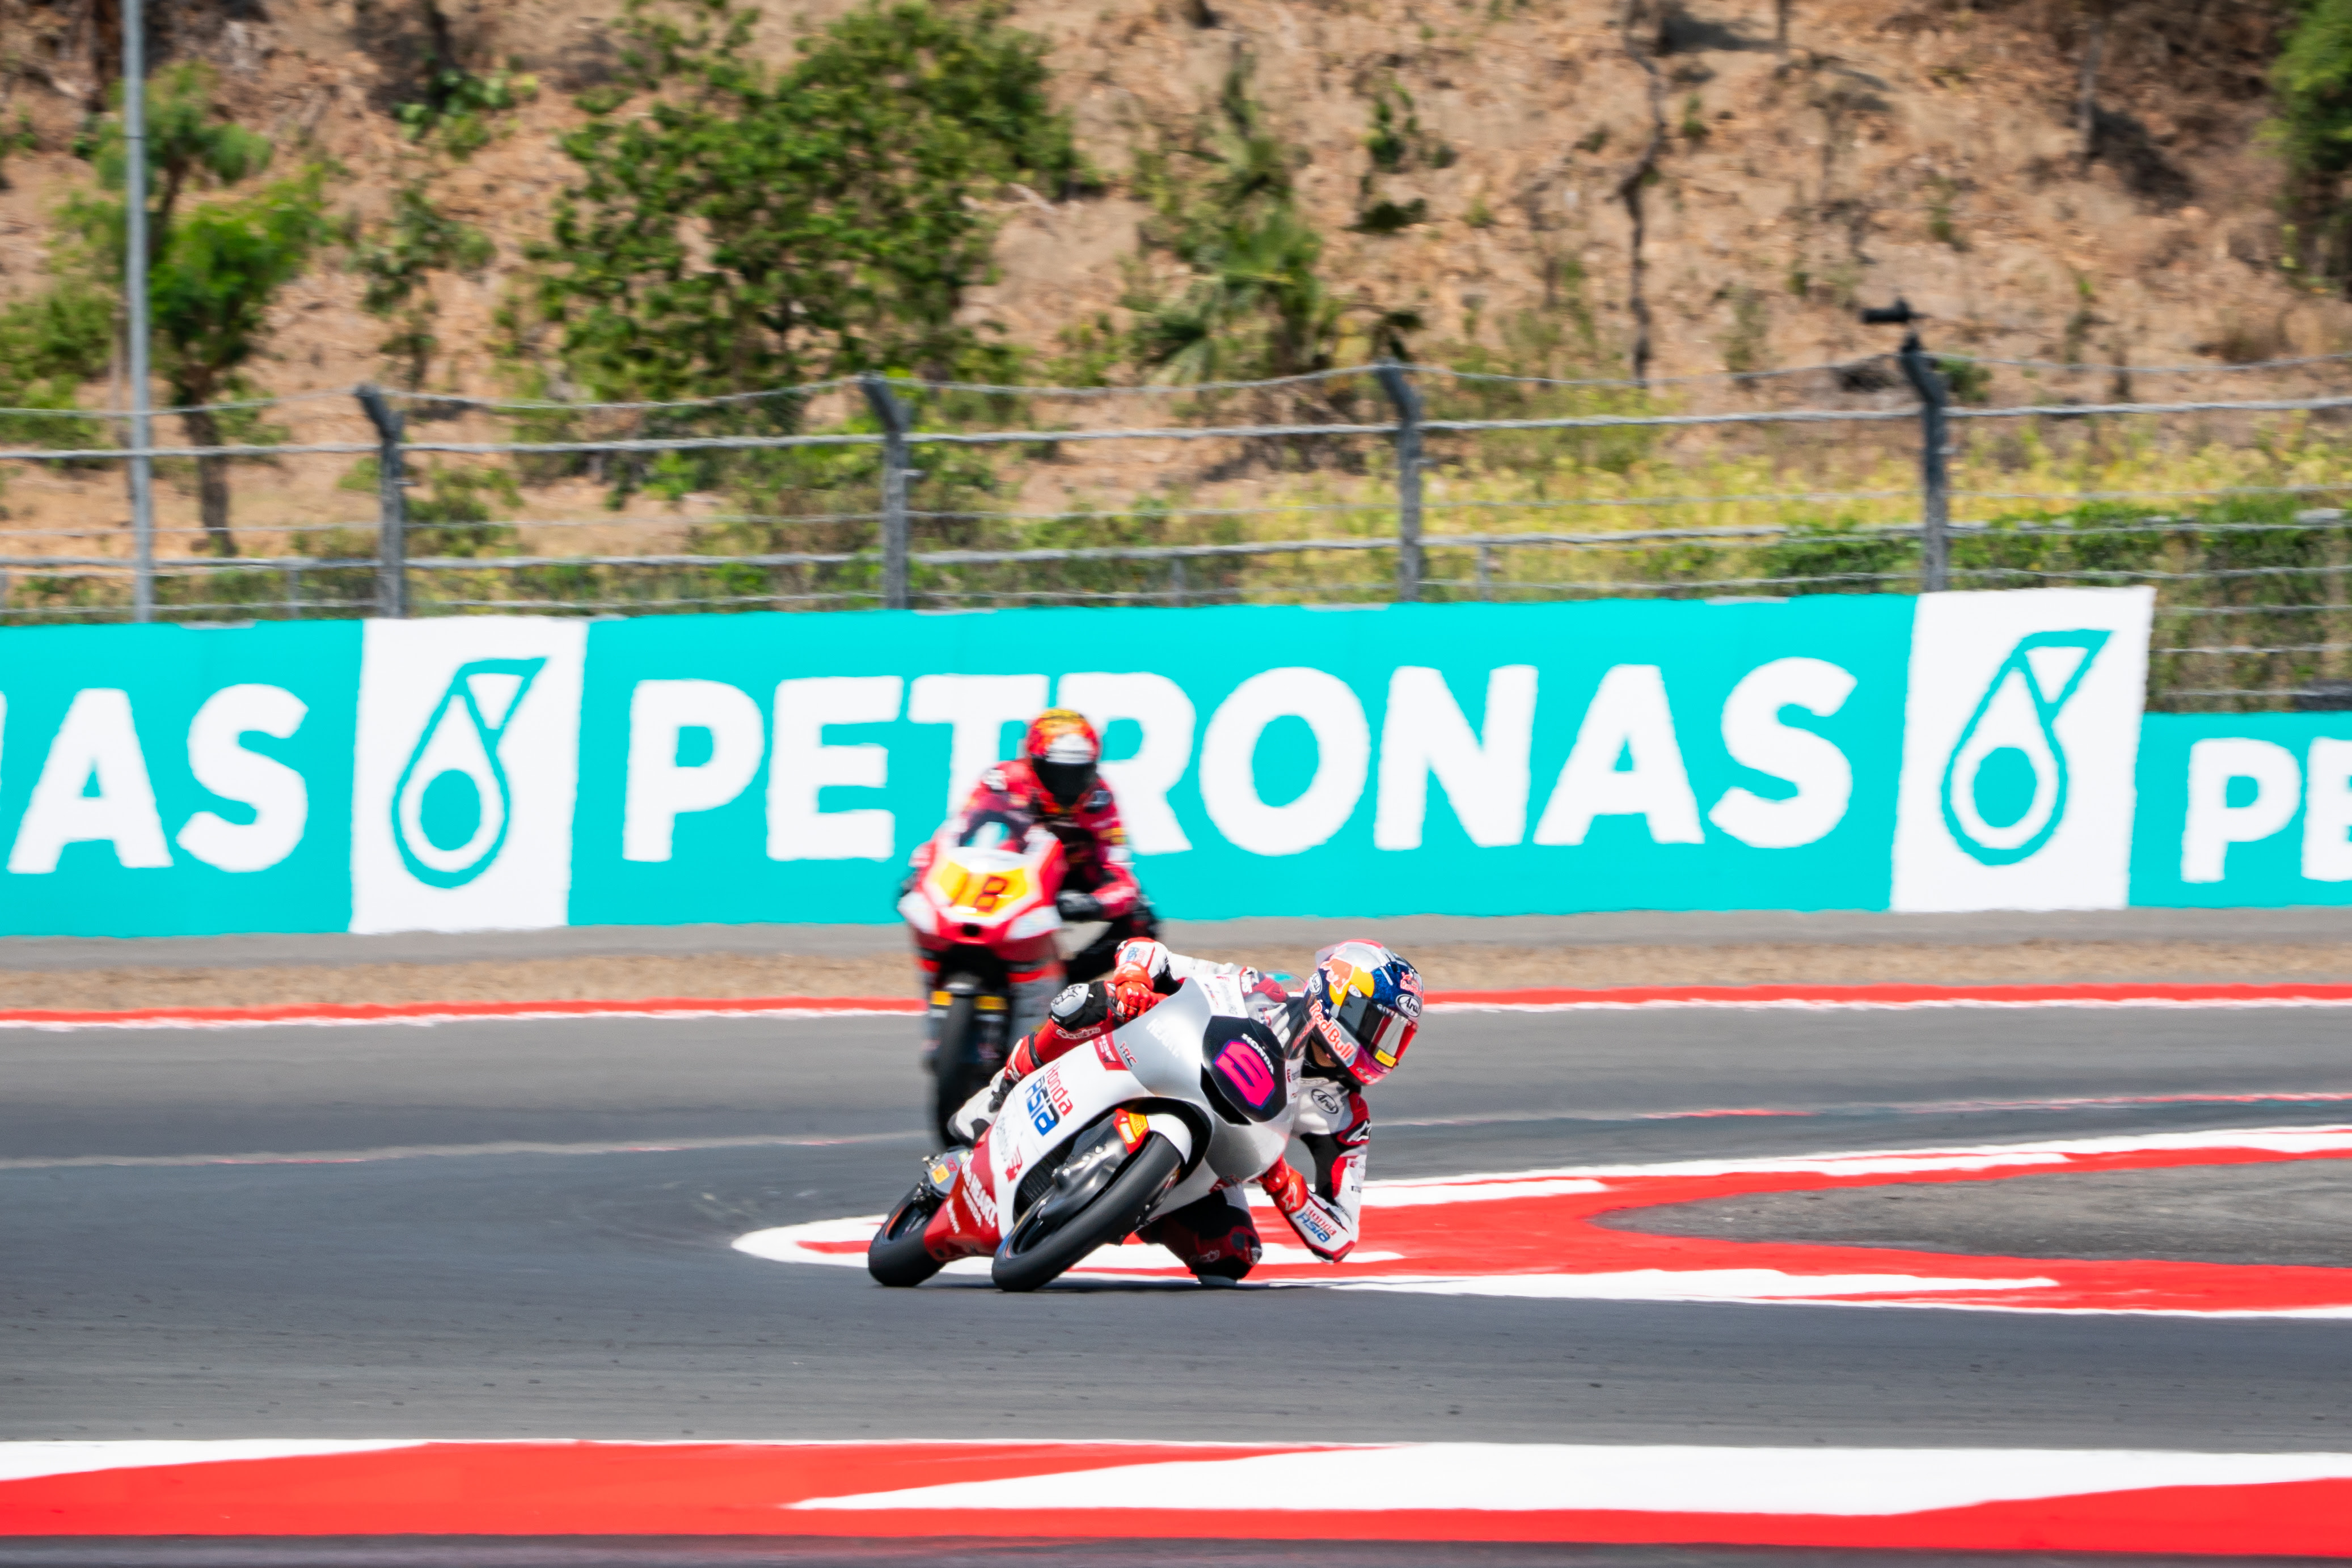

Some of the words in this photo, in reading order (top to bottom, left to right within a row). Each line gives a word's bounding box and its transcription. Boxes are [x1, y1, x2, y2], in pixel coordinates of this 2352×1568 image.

[0, 682, 309, 874] AS
[622, 656, 1858, 862] PETRONAS
[1241, 1033, 1274, 1075] HONDA
[1309, 1000, 1332, 1033] Red
[1327, 1026, 1356, 1060] Bull
[1045, 1062, 1074, 1117] Honda
[1306, 1206, 1337, 1236] Honda
